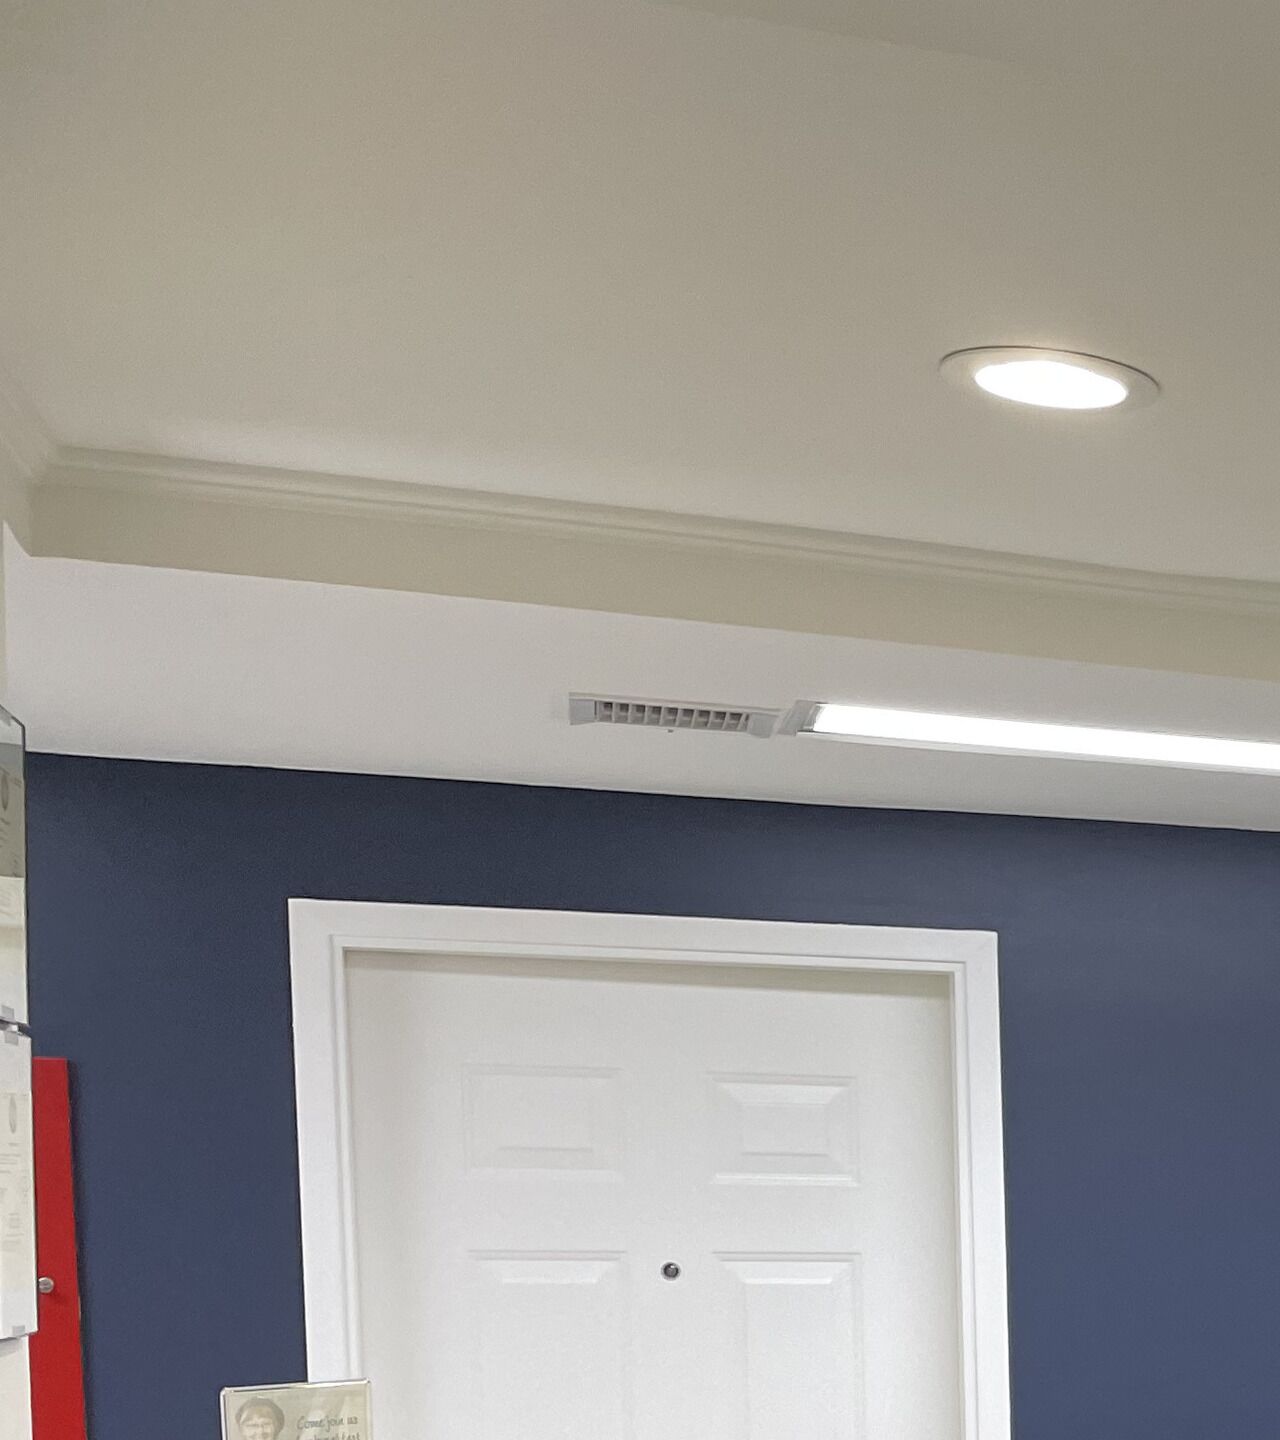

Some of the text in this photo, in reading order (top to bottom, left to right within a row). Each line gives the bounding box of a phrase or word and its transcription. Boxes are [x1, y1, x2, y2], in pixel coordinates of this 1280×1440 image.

[297, 1416, 358, 1432] Come join us
